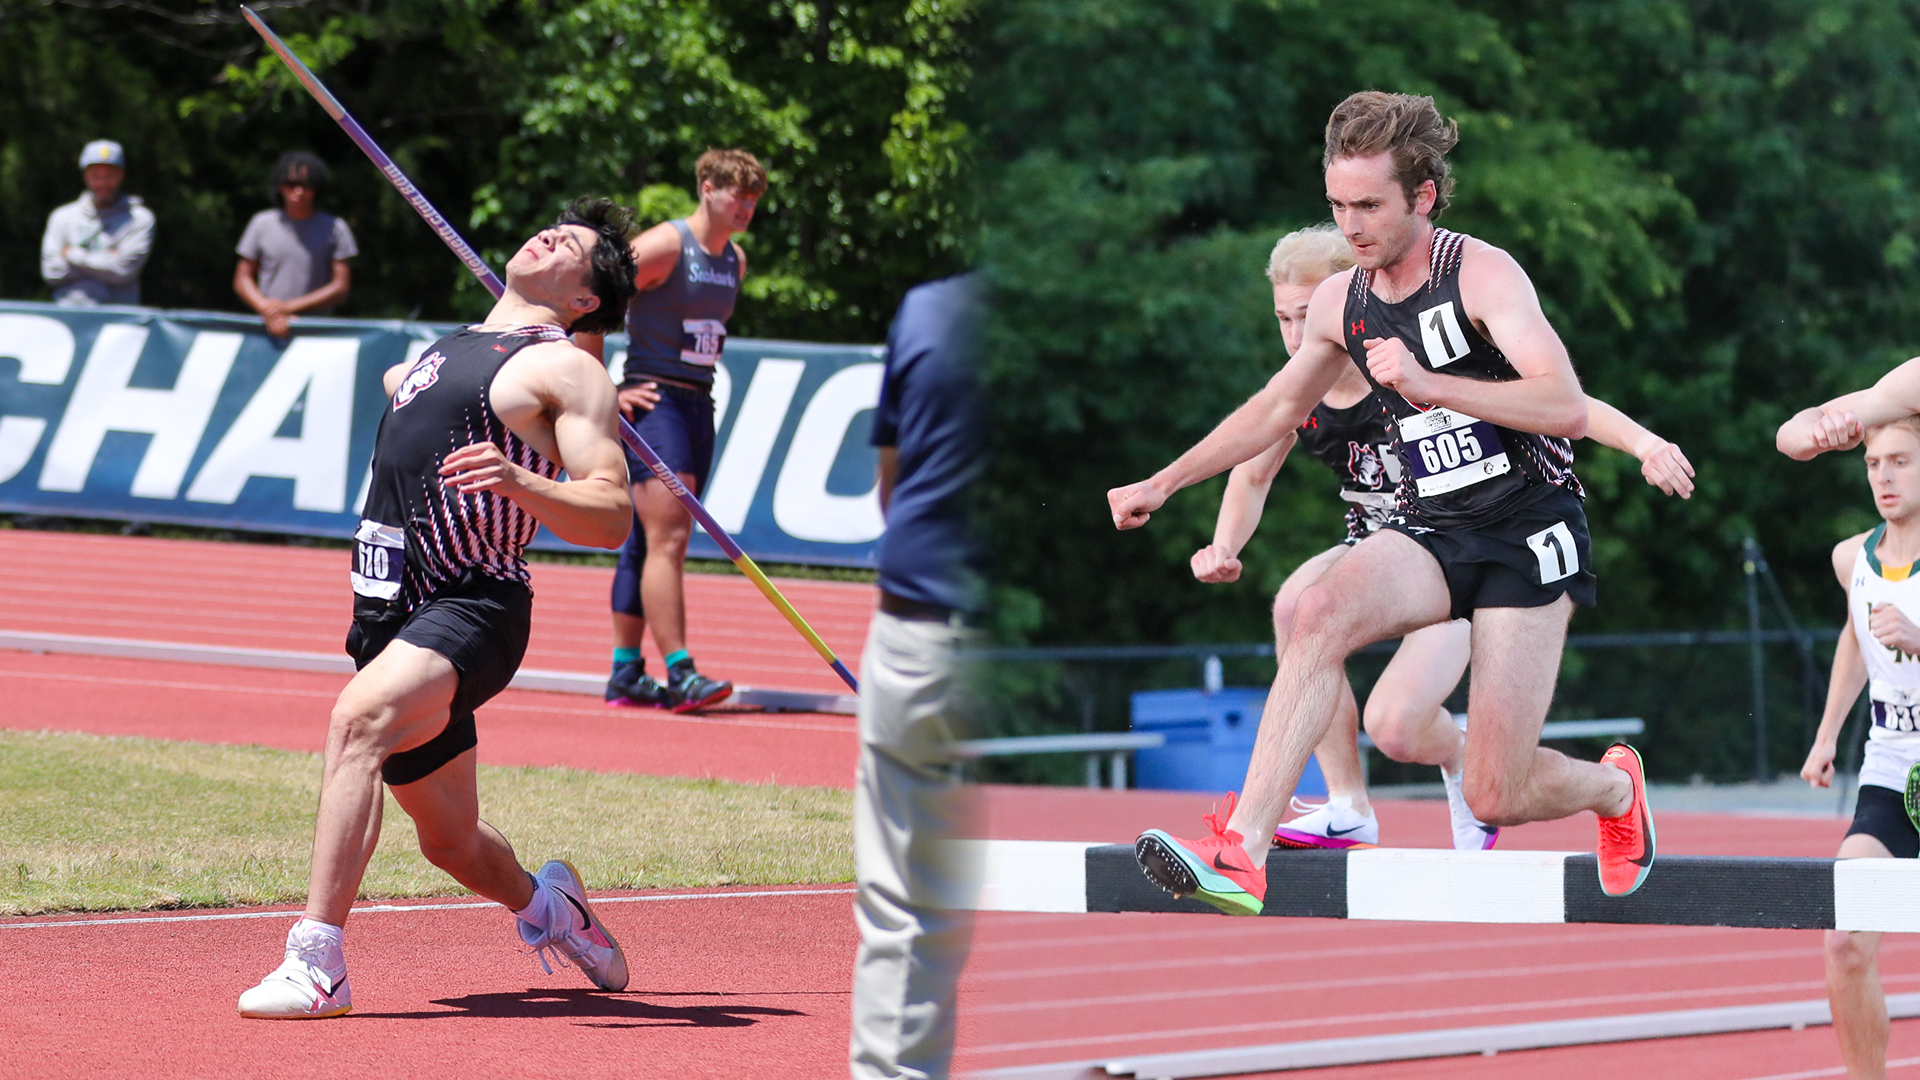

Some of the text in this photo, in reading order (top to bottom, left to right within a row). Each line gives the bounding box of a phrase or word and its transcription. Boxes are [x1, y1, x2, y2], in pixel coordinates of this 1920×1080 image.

[383, 161, 416, 196] 80m
[439, 225, 490, 277] Nemeth
[693, 332, 720, 355] 765
[1429, 310, 1457, 360] 1
[1418, 426, 1484, 474] 605
[358, 541, 389, 580] 610
[1542, 530, 1567, 577] 1
